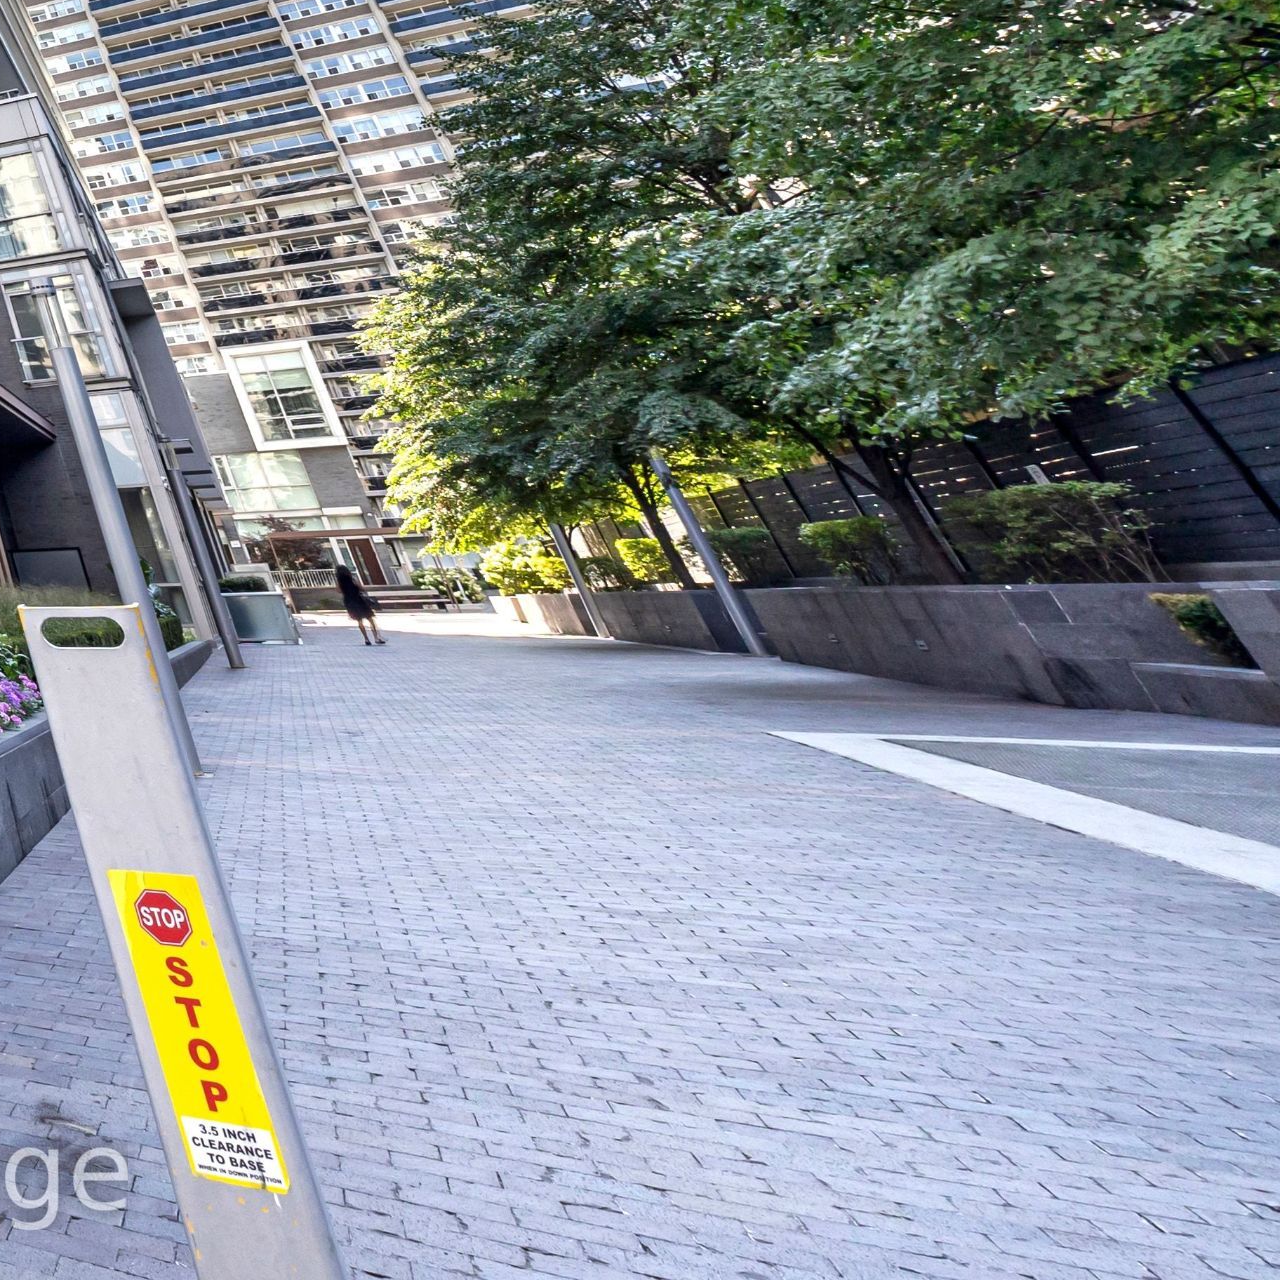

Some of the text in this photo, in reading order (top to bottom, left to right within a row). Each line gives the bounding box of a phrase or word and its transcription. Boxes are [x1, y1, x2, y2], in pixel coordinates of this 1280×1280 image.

[140, 905, 185, 930] STOP
[165, 956, 228, 1113] STOP
[198, 1123, 257, 1144] 3.5 INCH
[191, 1136, 274, 1160] CLEARANCE
[206, 1152, 266, 1173] TO BASE
[228, 1169, 249, 1178] DOWN
[249, 1173, 283, 1185] POSTION
